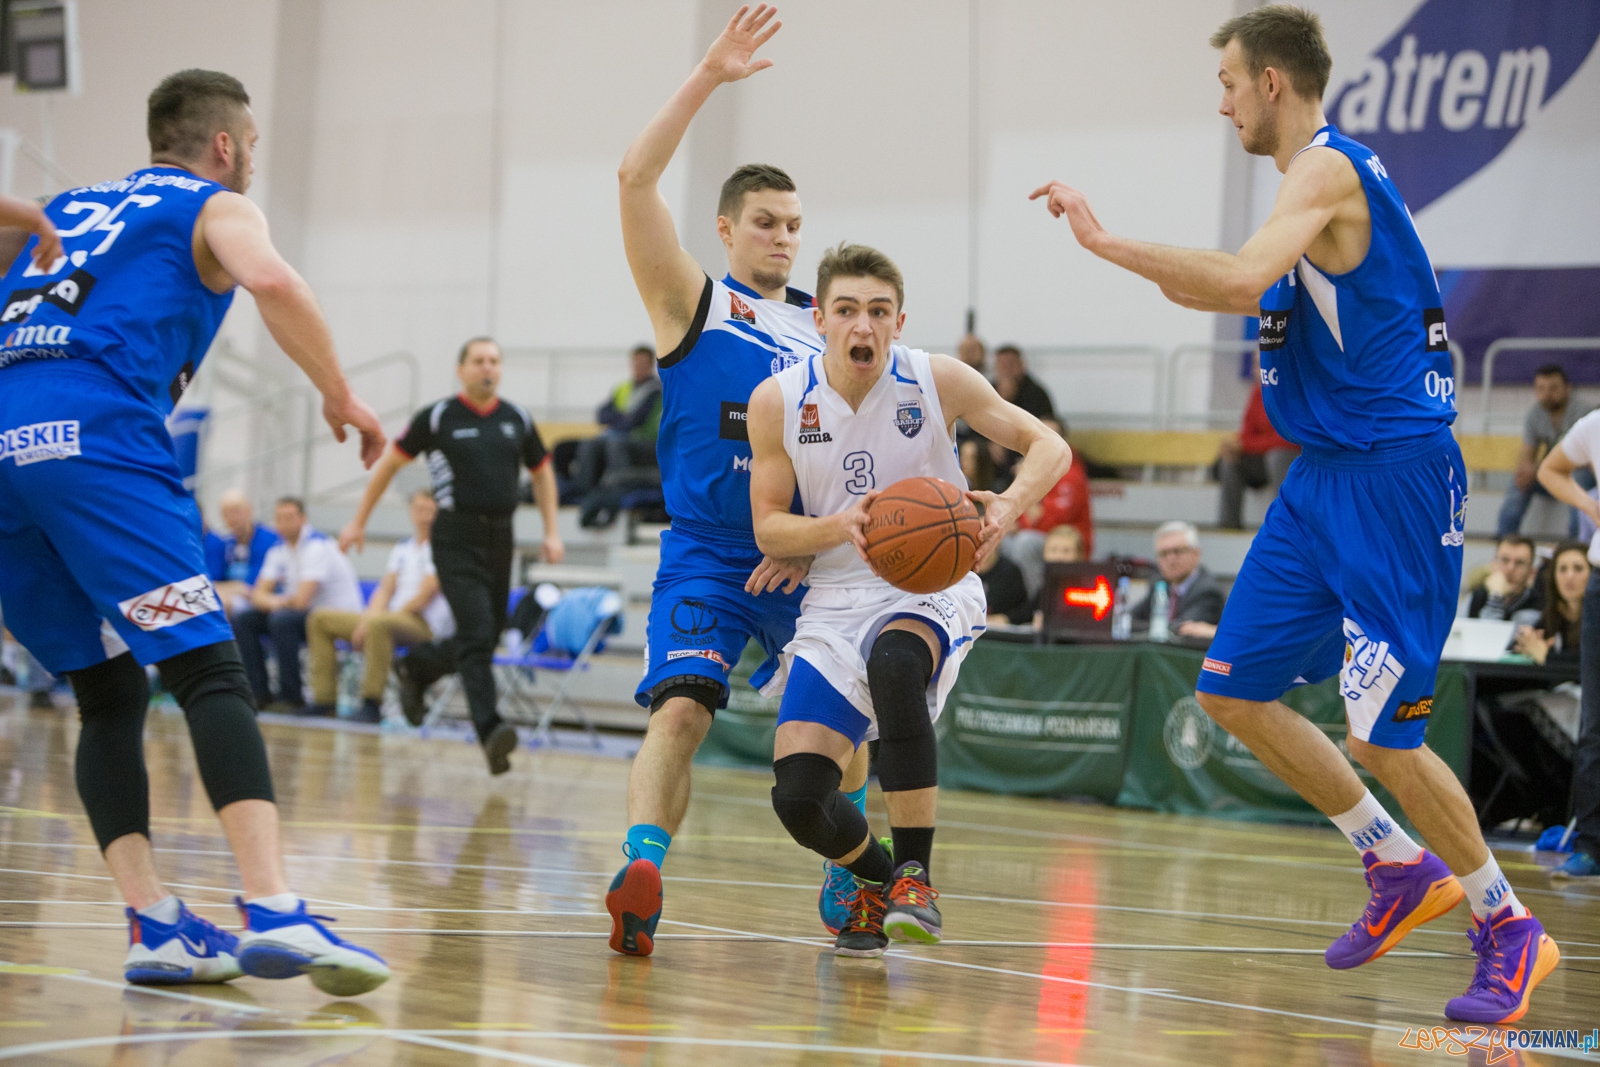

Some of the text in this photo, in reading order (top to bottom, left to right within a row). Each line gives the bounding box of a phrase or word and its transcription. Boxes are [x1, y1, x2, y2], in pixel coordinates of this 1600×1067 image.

[1337, 34, 1550, 134] atrem
[893, 417, 926, 426] BASKET
[843, 451, 876, 495] 3
